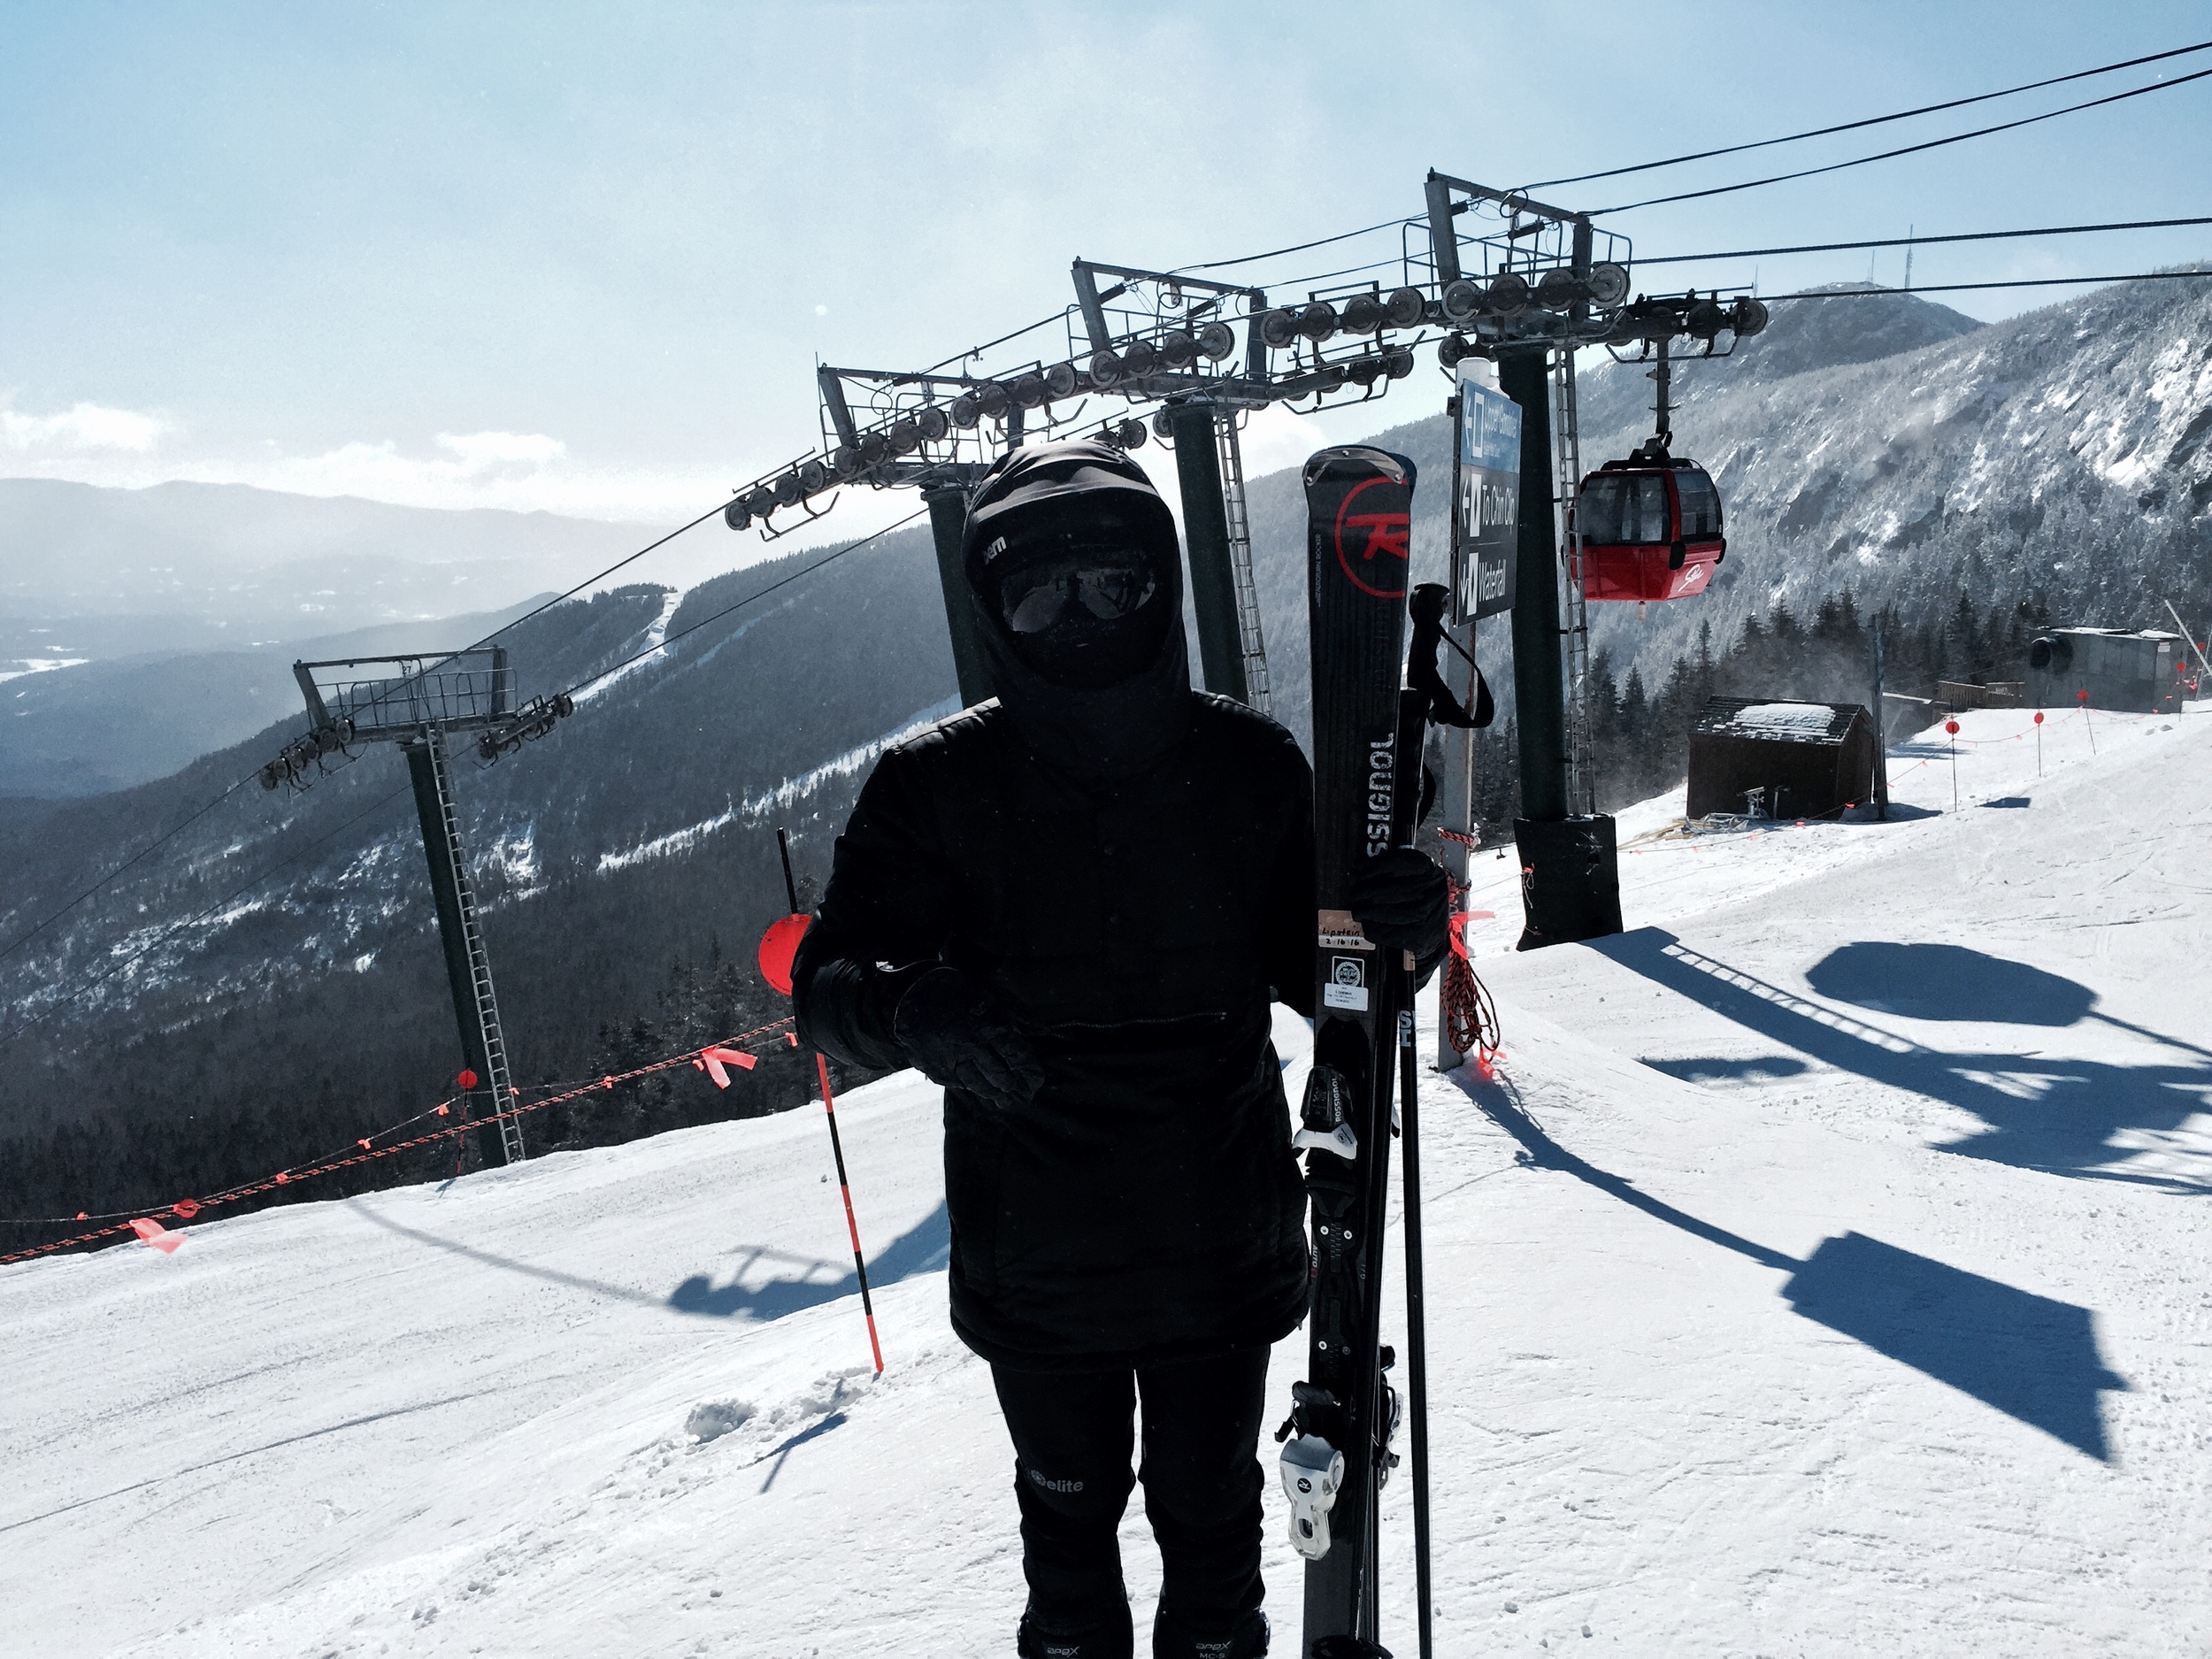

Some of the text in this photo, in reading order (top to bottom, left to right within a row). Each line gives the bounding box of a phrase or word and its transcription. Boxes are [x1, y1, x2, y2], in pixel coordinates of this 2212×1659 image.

[1482, 484, 1515, 534] To Chin Clip
[1479, 558, 1507, 602] Waterfall
[1332, 1076, 1342, 1123] ROSSIGNOL
[1047, 1479, 1084, 1493] elite
